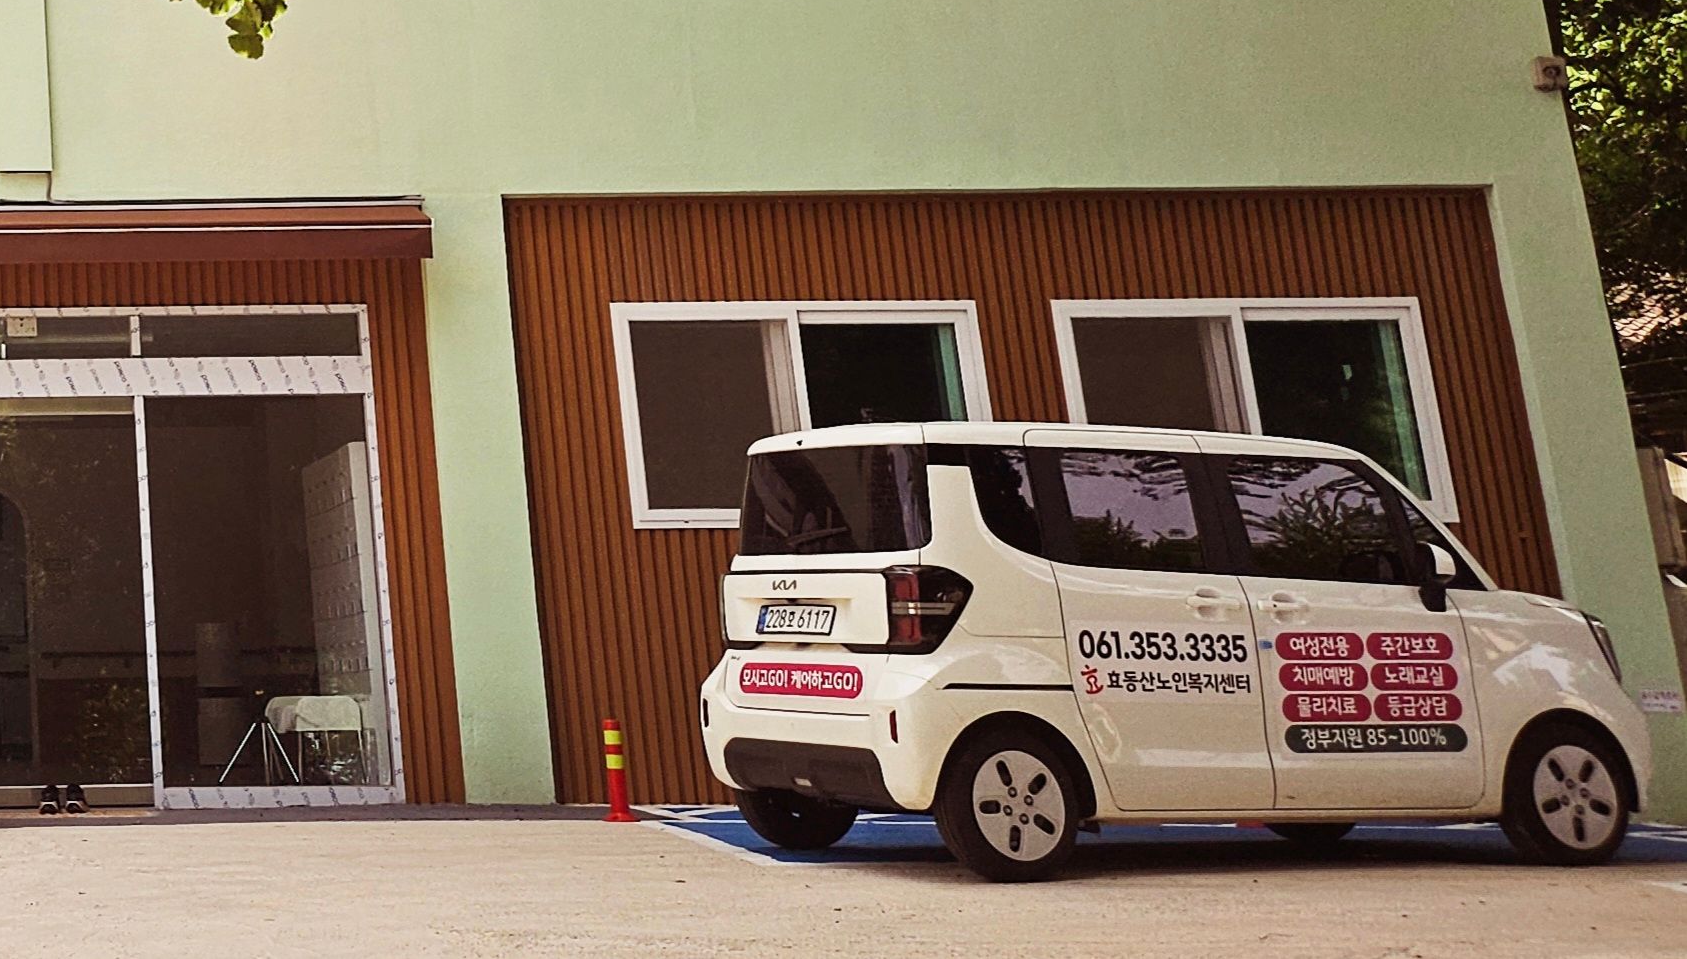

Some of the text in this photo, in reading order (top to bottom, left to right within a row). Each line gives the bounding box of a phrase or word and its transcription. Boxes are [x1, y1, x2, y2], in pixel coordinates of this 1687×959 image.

[797, 609, 830, 629] 6117
[1078, 629, 1248, 663] 061.353.3335
[1289, 636, 1350, 657] 여성전용
[1380, 636, 1440, 657] 주간보호
[1107, 671, 1252, 694] 효동산노인복지센터
[1292, 666, 1354, 687] 치매예방
[1385, 666, 1444, 687] 노래교실
[1297, 696, 1358, 718] 물리치료
[1387, 696, 1447, 717] 등급상담
[1300, 727, 1447, 750] 정부지원 85~100%
